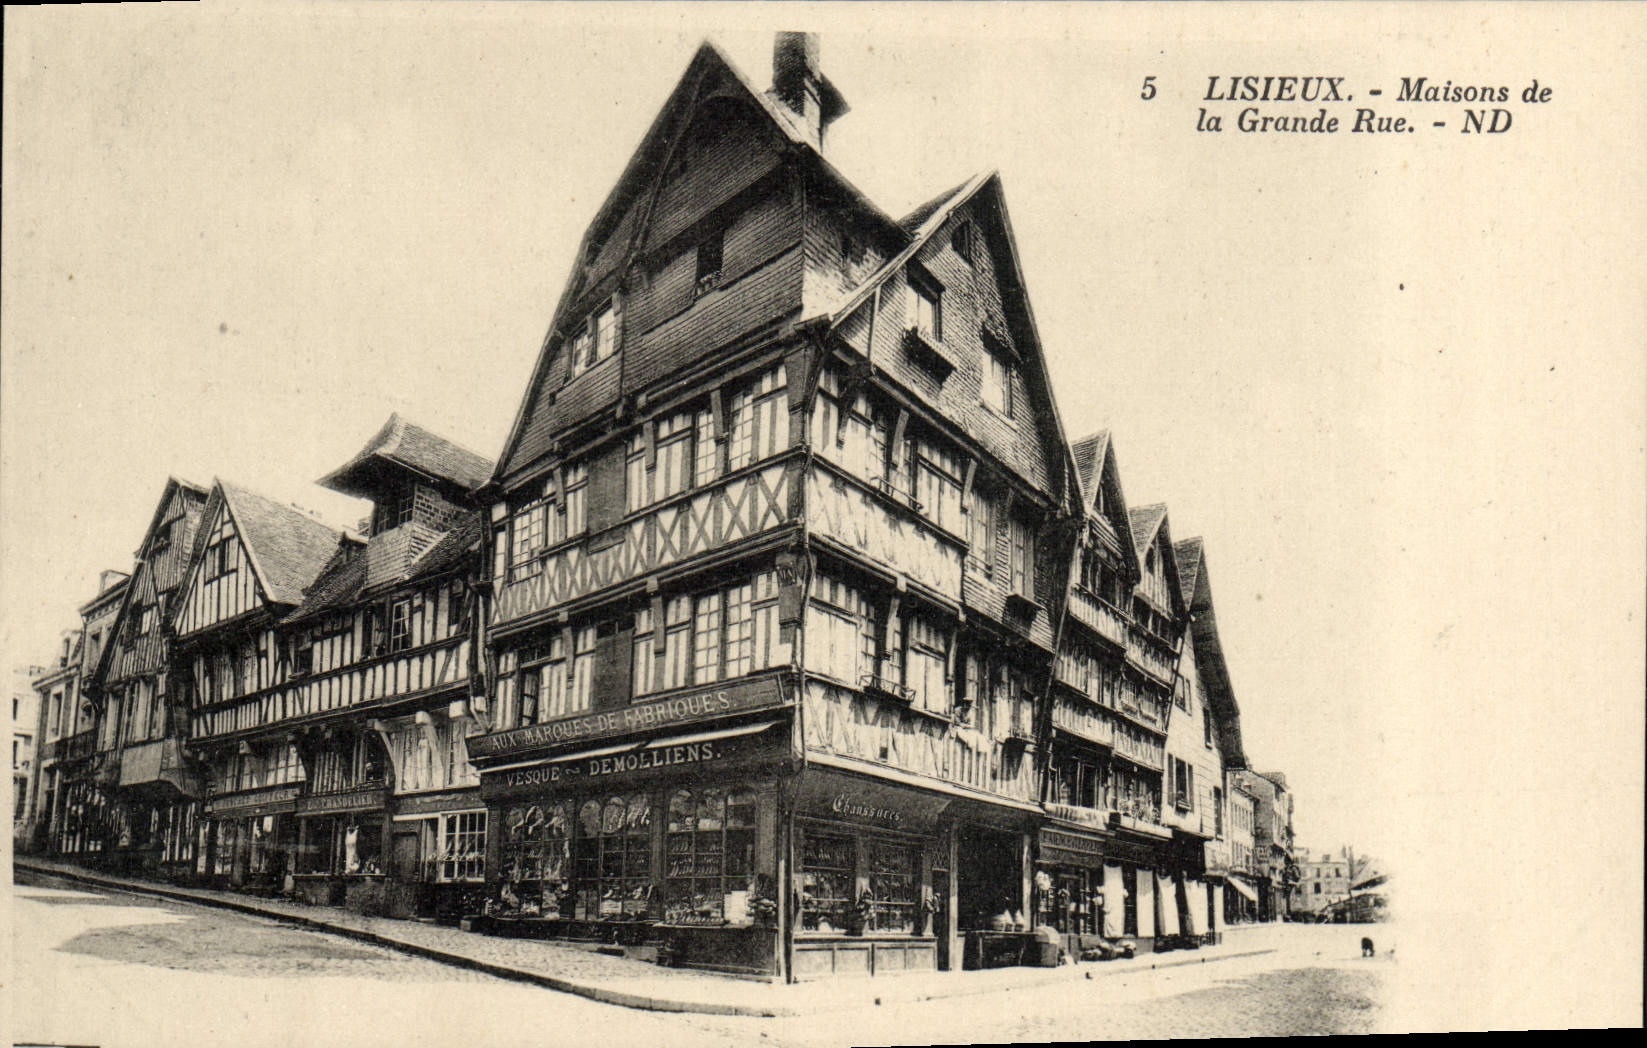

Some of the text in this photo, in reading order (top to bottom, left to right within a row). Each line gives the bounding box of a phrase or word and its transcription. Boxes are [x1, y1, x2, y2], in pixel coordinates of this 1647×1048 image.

[491, 733, 518, 750] AUX
[525, 719, 592, 745] MARQUES
[599, 713, 617, 731] DE
[506, 767, 560, 787] VESQUE
